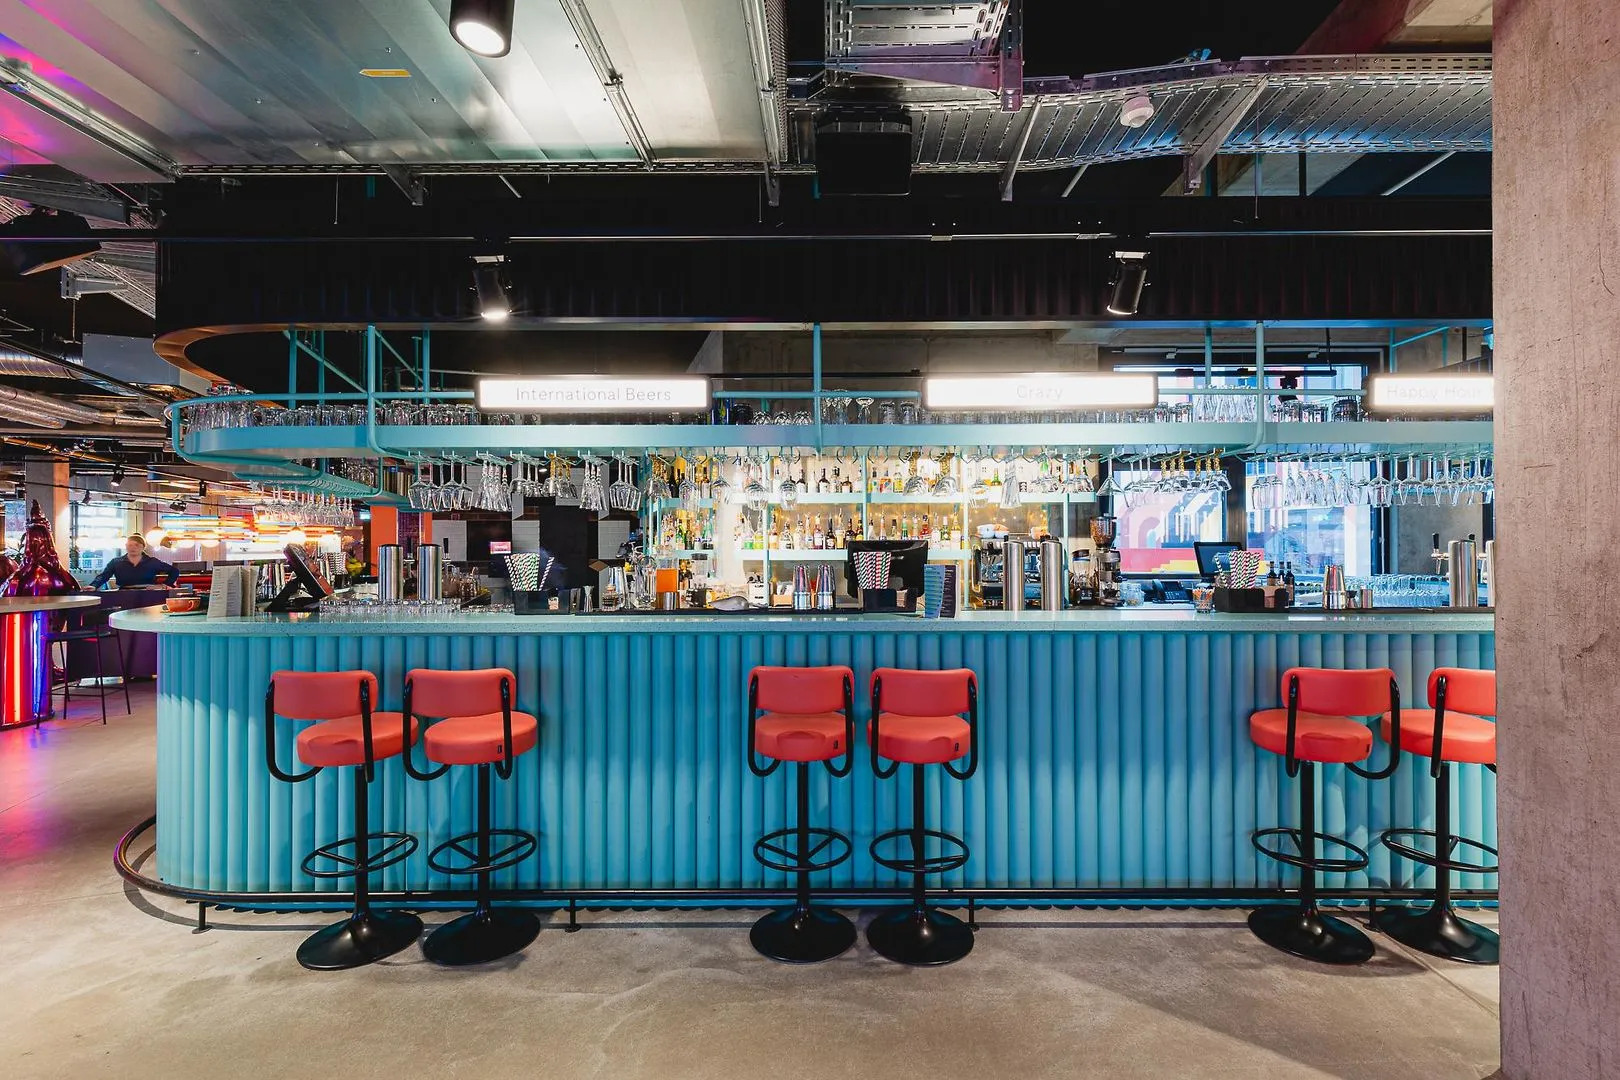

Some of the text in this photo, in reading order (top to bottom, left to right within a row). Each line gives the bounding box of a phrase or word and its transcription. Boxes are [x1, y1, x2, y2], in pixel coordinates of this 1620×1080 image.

[516, 387, 671, 401] International Beers
[1016, 384, 1063, 402] Crazy
[1387, 384, 1438, 402] Happy
